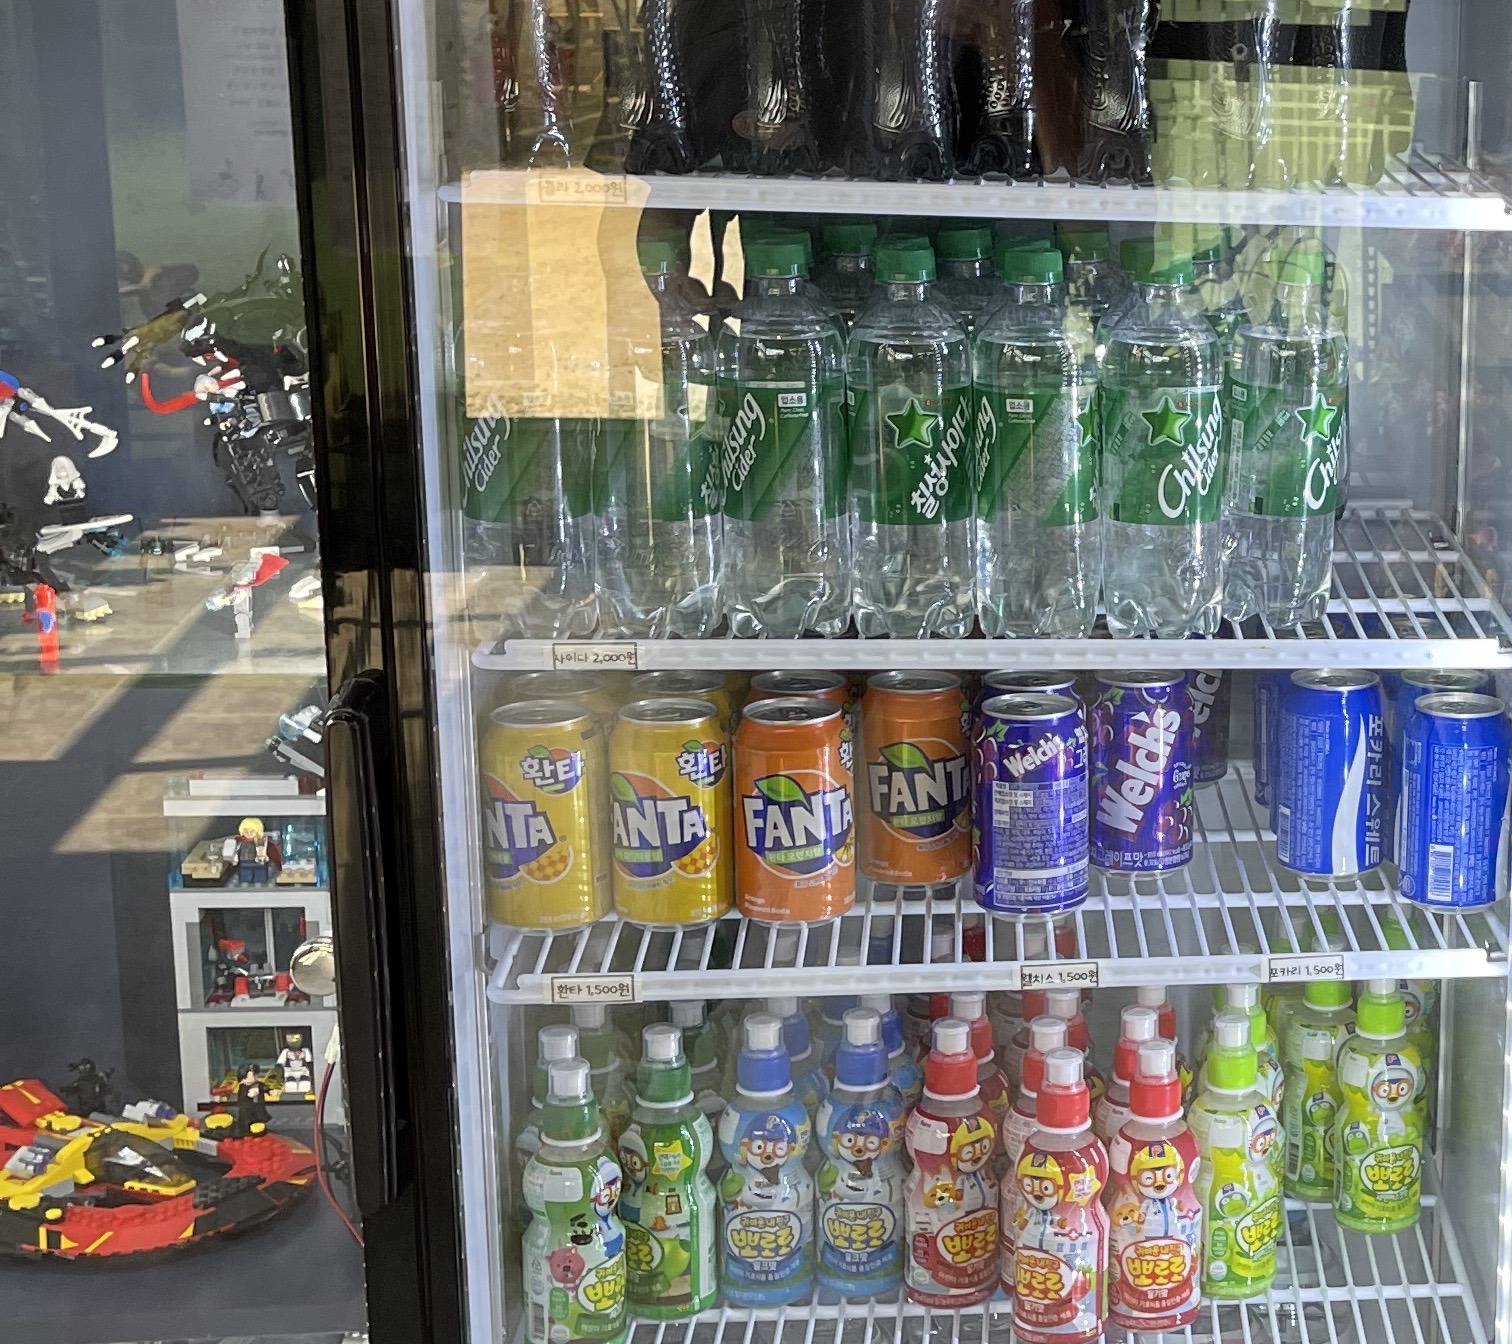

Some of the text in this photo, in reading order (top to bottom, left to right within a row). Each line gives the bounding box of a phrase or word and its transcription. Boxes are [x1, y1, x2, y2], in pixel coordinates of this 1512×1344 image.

[474, 434, 502, 492] Cider
[731, 435, 758, 492] Cider
[1157, 393, 1223, 519] Chilsung
[555, 651, 636, 666] 사이다 2,000원
[519, 748, 584, 786] 환타
[1003, 733, 1063, 778] Welch's
[1096, 708, 1181, 834] Welch's
[1364, 713, 1384, 867] 포카리 스웨트
[487, 801, 556, 849] NTA
[613, 799, 707, 848] ANTA
[1058, 970, 1098, 984] 1,500원
[1270, 962, 1344, 978] 포카리 1,500원
[556, 984, 582, 999] 환타
[1365, 1158, 1415, 1192] 뽀로로
[730, 1225, 795, 1258] 뽀로로
[826, 1218, 887, 1250] 뽀로로
[1126, 1255, 1187, 1287] 뽀로로
